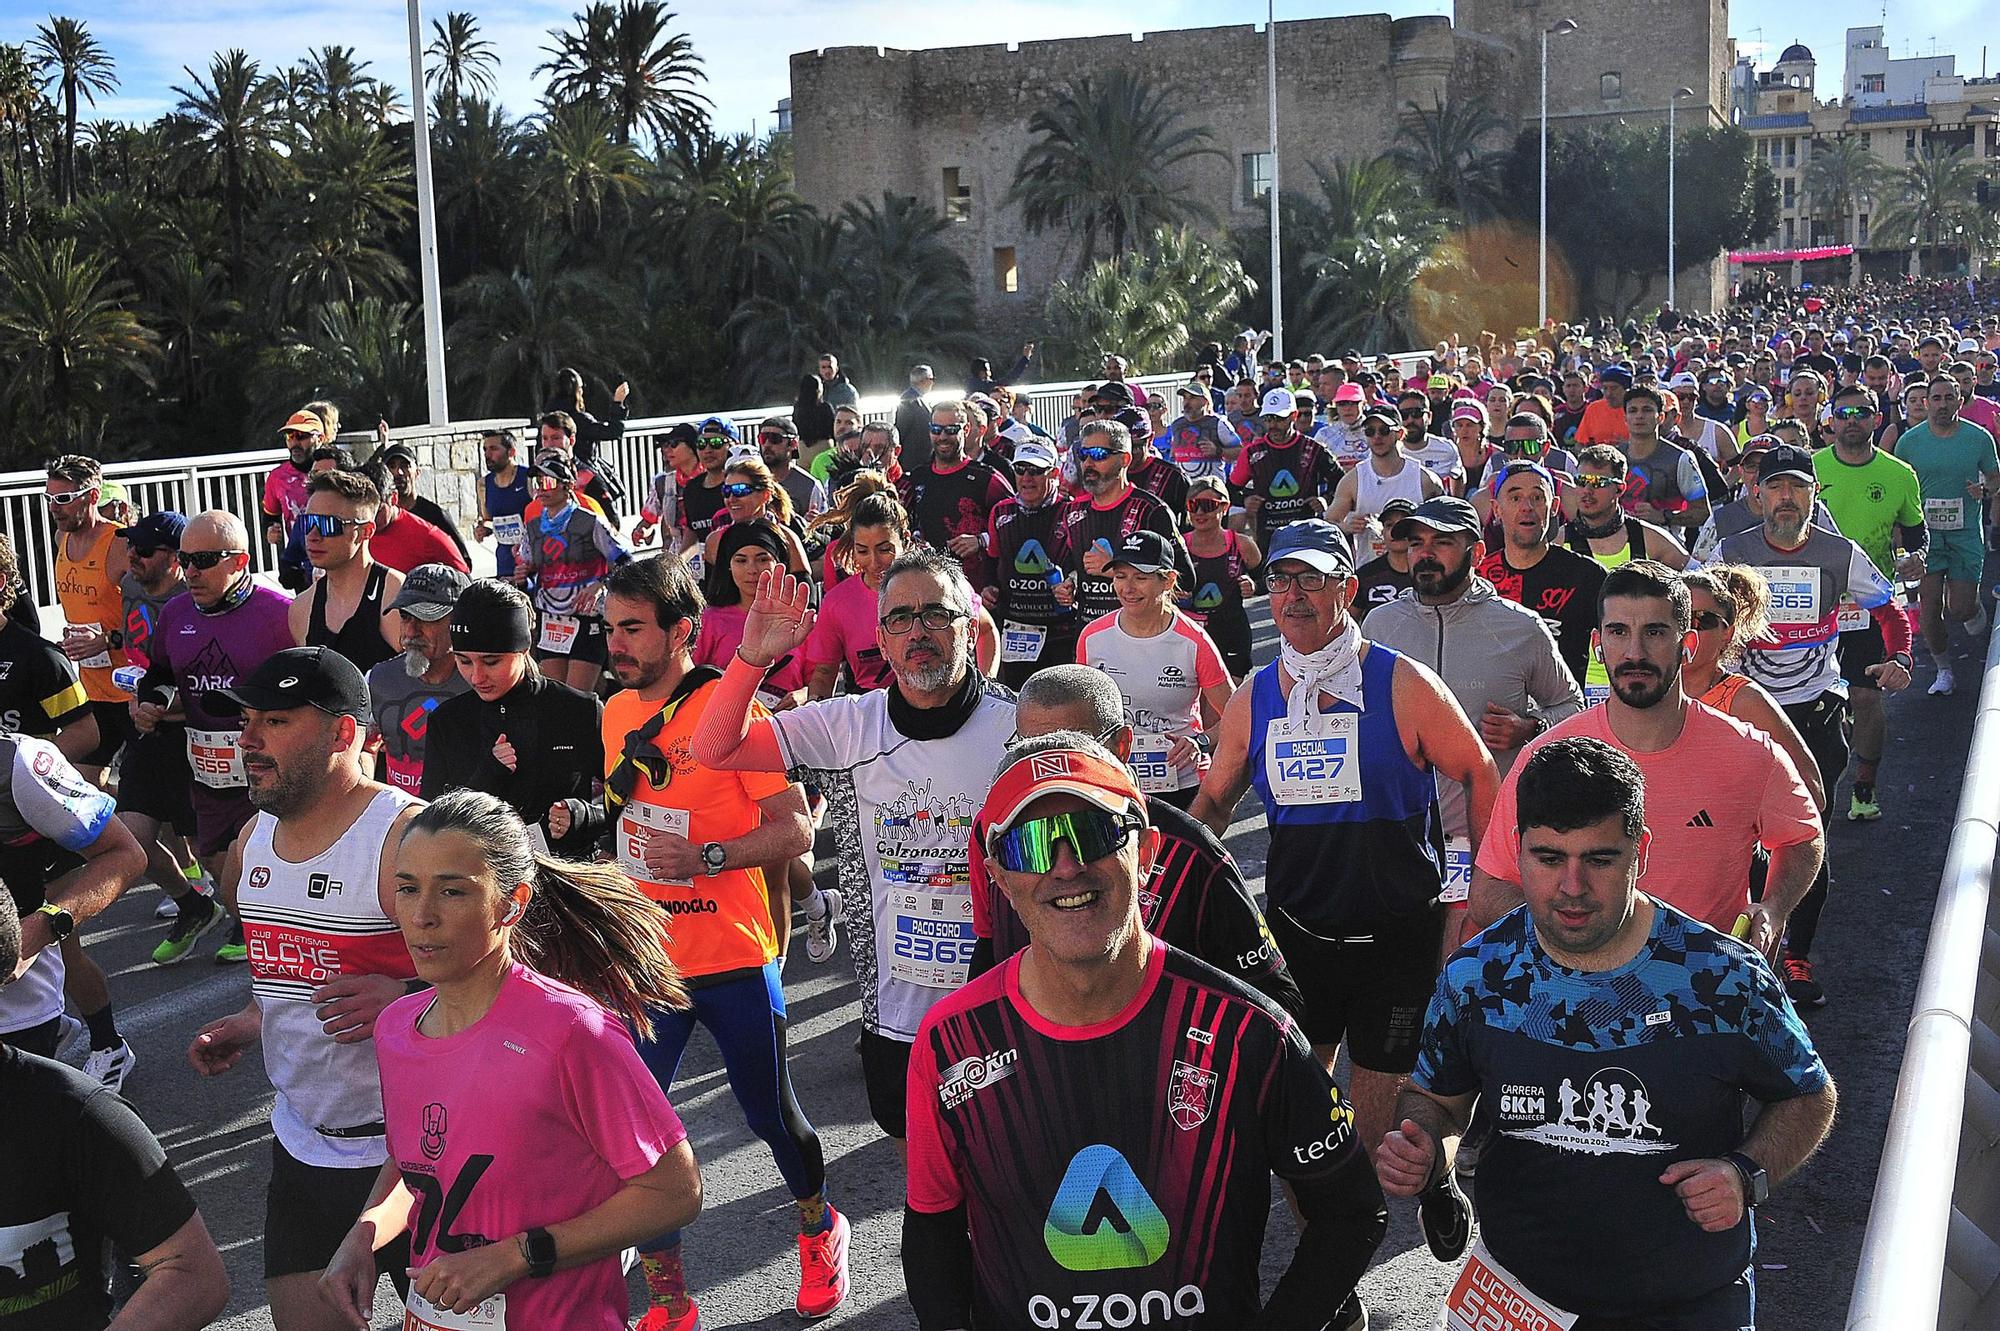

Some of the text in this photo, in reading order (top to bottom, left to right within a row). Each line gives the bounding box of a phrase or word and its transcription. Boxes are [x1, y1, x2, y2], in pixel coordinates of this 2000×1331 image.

[1535, 587, 1577, 615] SOY
[1788, 625, 1830, 640] ELCHE
[1005, 641, 1038, 653] 1534
[186, 674, 236, 692] DARK
[1292, 740, 1328, 756] PASCUAL
[1277, 756, 1345, 782] 1427
[907, 874, 928, 883] Jorge
[912, 920, 961, 938] PACO SORO
[251, 930, 330, 948] CLUB ATLETISMO
[250, 939, 341, 969] ELCHE
[1501, 1084, 1546, 1097] CARRERA
[1500, 1095, 1546, 1114] 6KM
[1508, 1113, 1546, 1121] AMANECER
[1544, 1132, 1611, 1148] SANTA POLA 2022
